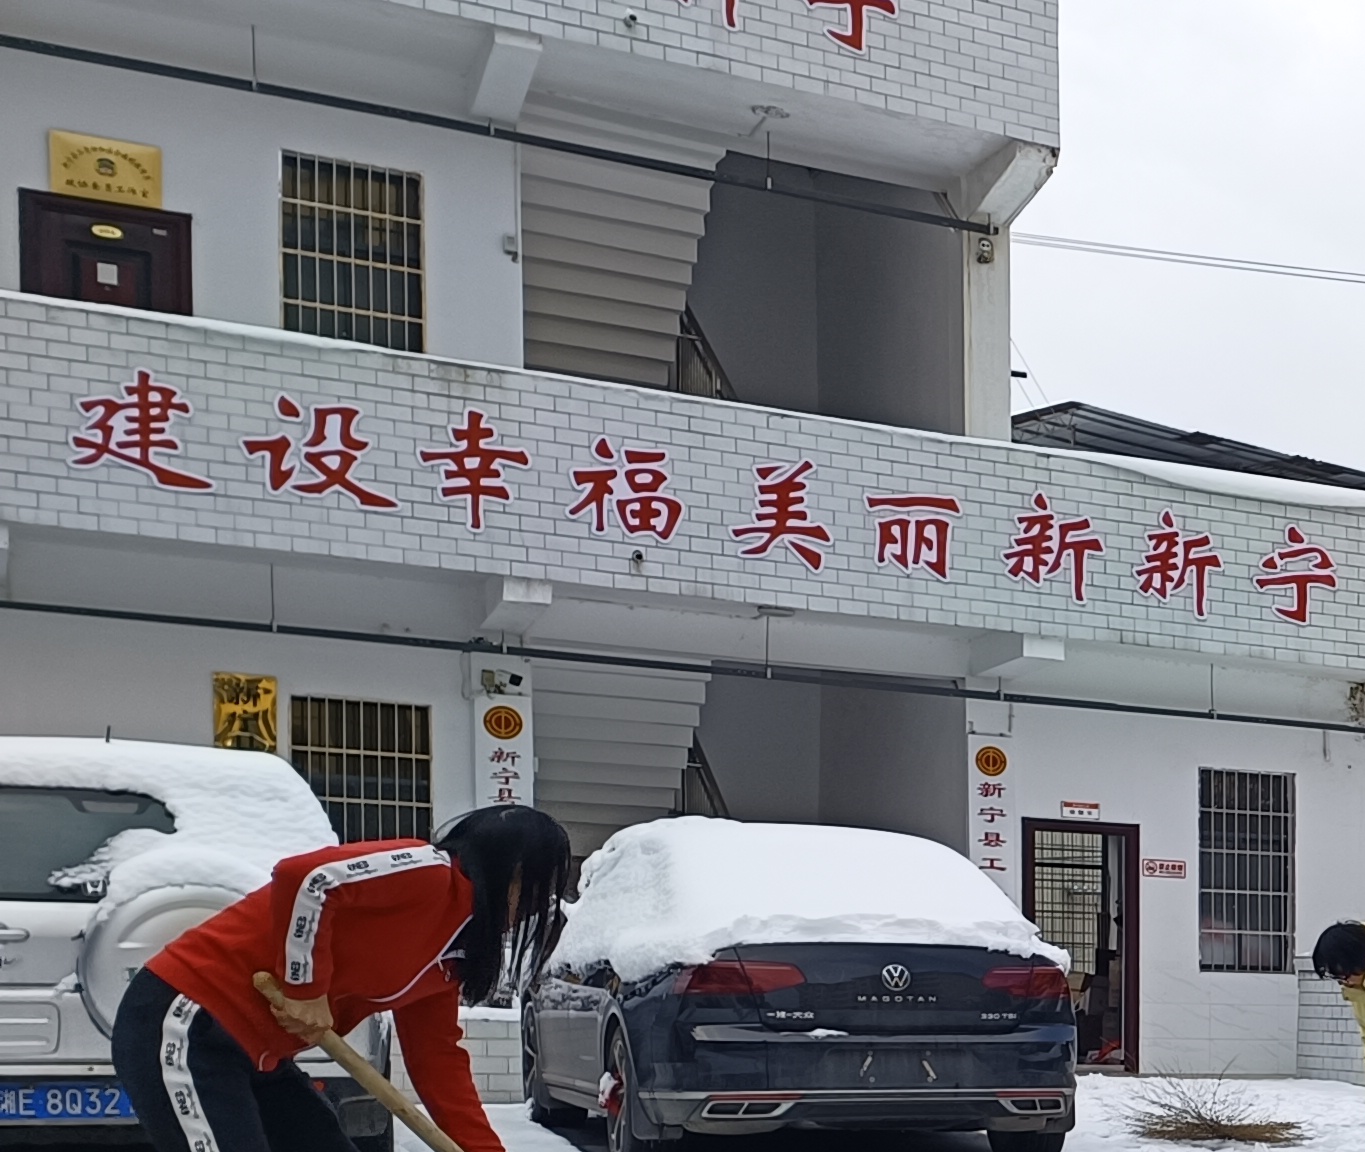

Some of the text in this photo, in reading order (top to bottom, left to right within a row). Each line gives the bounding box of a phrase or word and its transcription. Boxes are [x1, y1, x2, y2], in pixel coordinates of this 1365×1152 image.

[71, 368, 1338, 624] 建设幸福美丽新新宁
[976, 782, 1007, 872] 新宁县工
[857, 995, 937, 1003] MAGOTAN
